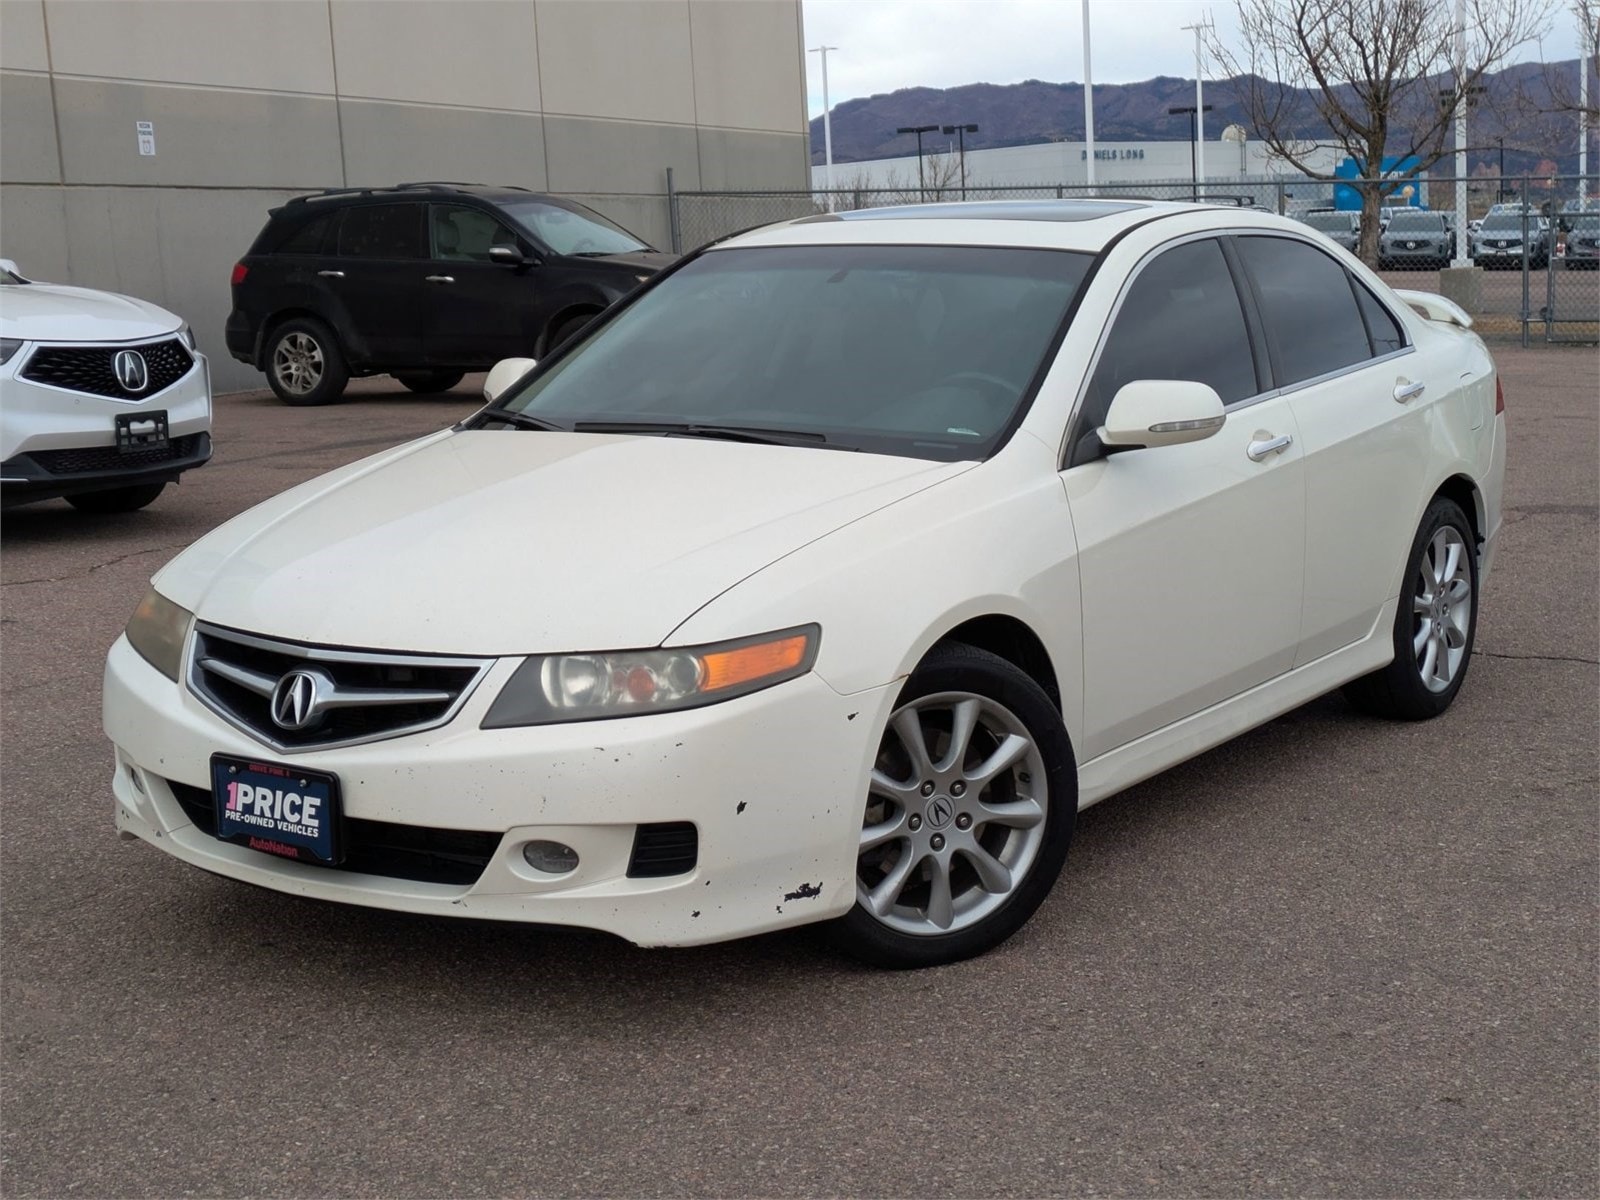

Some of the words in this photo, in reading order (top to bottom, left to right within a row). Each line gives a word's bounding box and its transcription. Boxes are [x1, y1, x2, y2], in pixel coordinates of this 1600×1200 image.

[1081, 149, 1118, 160] DNIELS
[1120, 149, 1145, 160] LONG
[226, 782, 320, 827] 1PRICE
[225, 811, 274, 828] PRE-OWNED
[277, 821, 318, 838] VEHICLES
[249, 837, 297, 857] AutoNation
